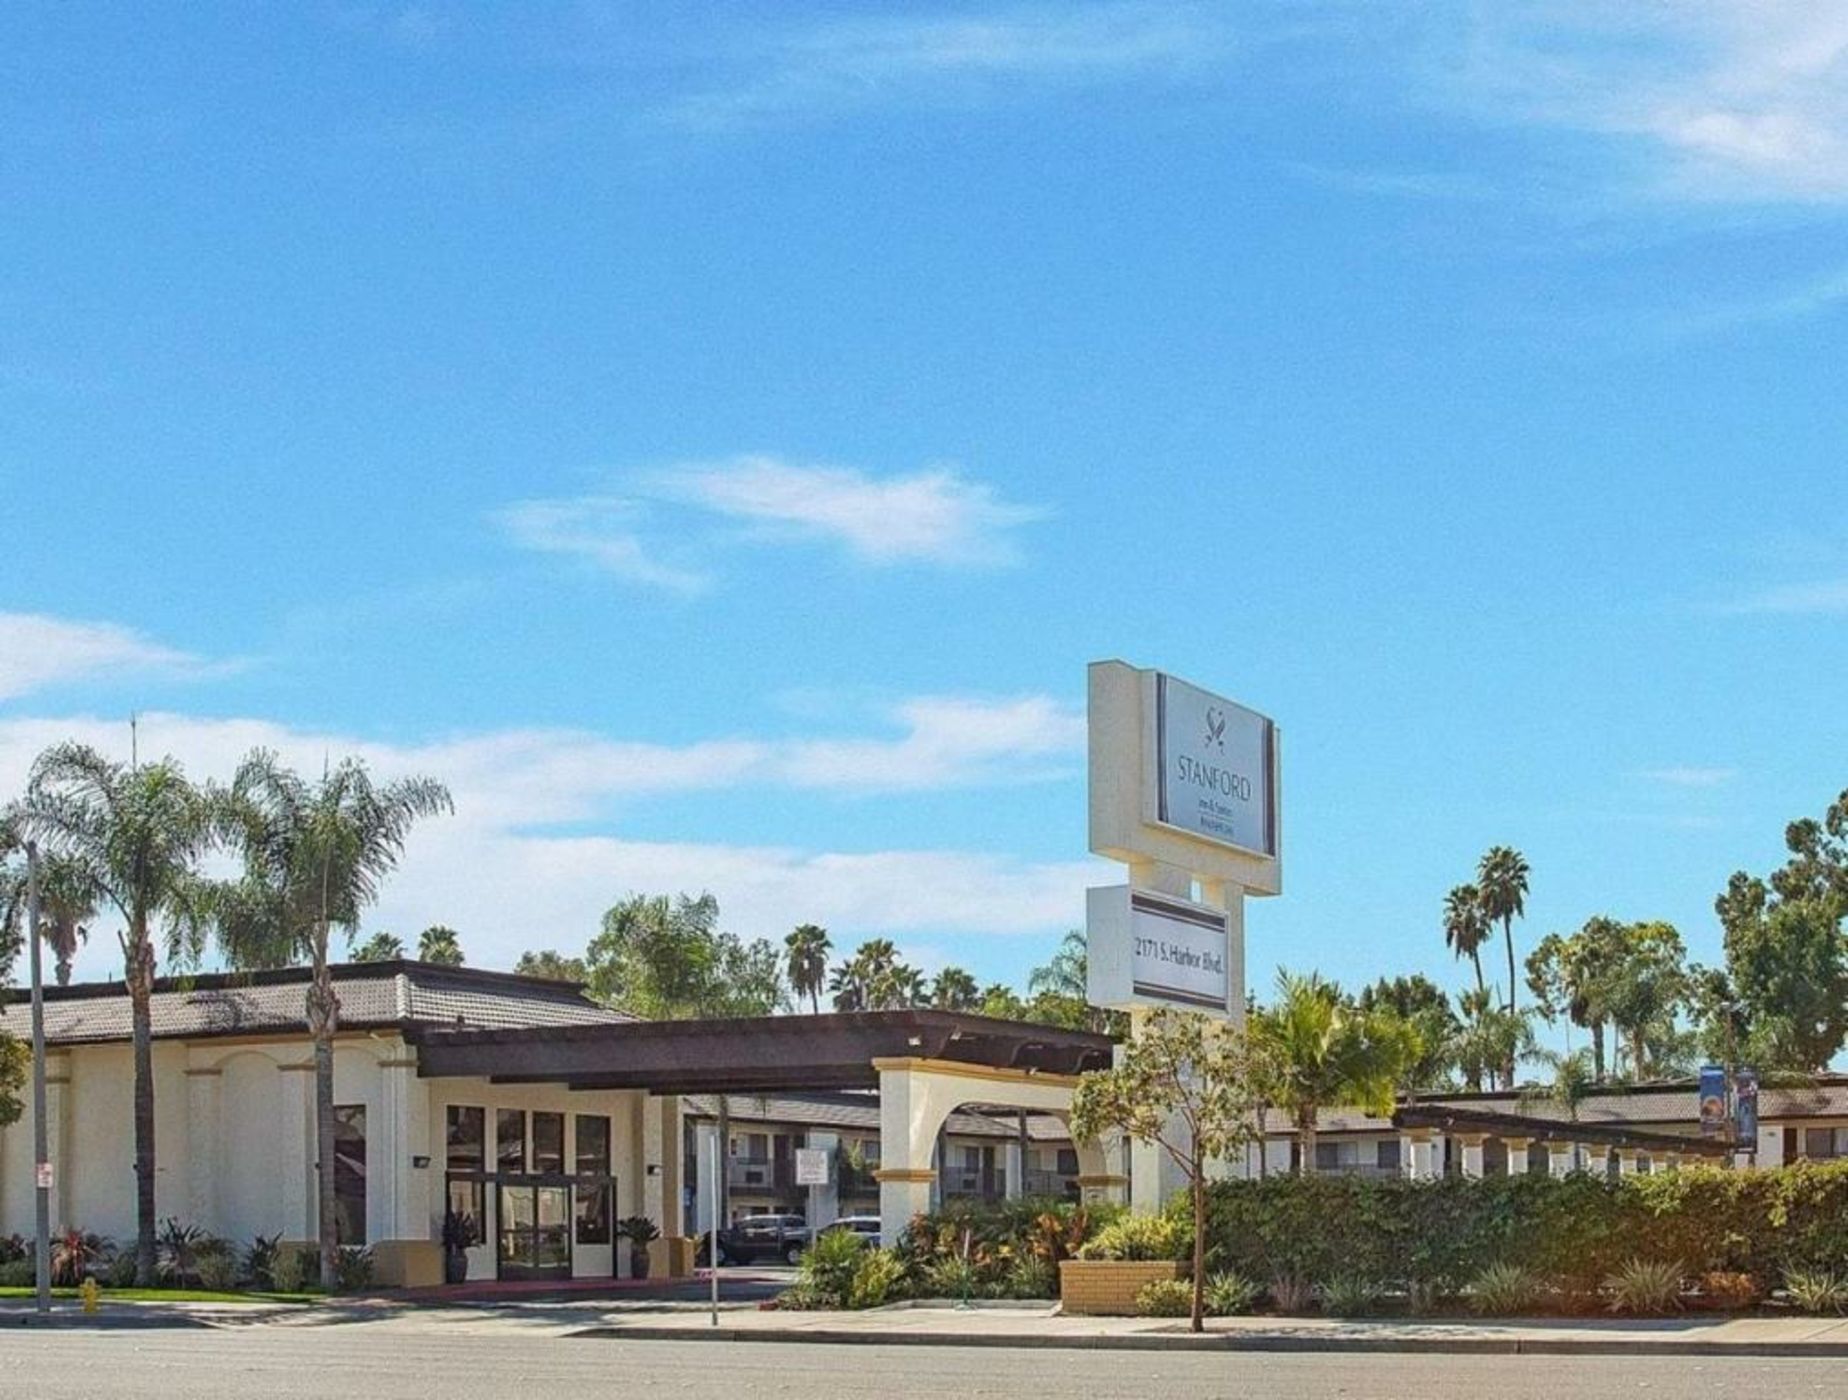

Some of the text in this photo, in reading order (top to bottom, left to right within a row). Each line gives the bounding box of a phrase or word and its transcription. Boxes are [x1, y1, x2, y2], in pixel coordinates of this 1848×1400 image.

[1178, 755, 1251, 802] STANFORD
[1134, 936, 1158, 959] 2171
[1169, 944, 1200, 968] Harbor
